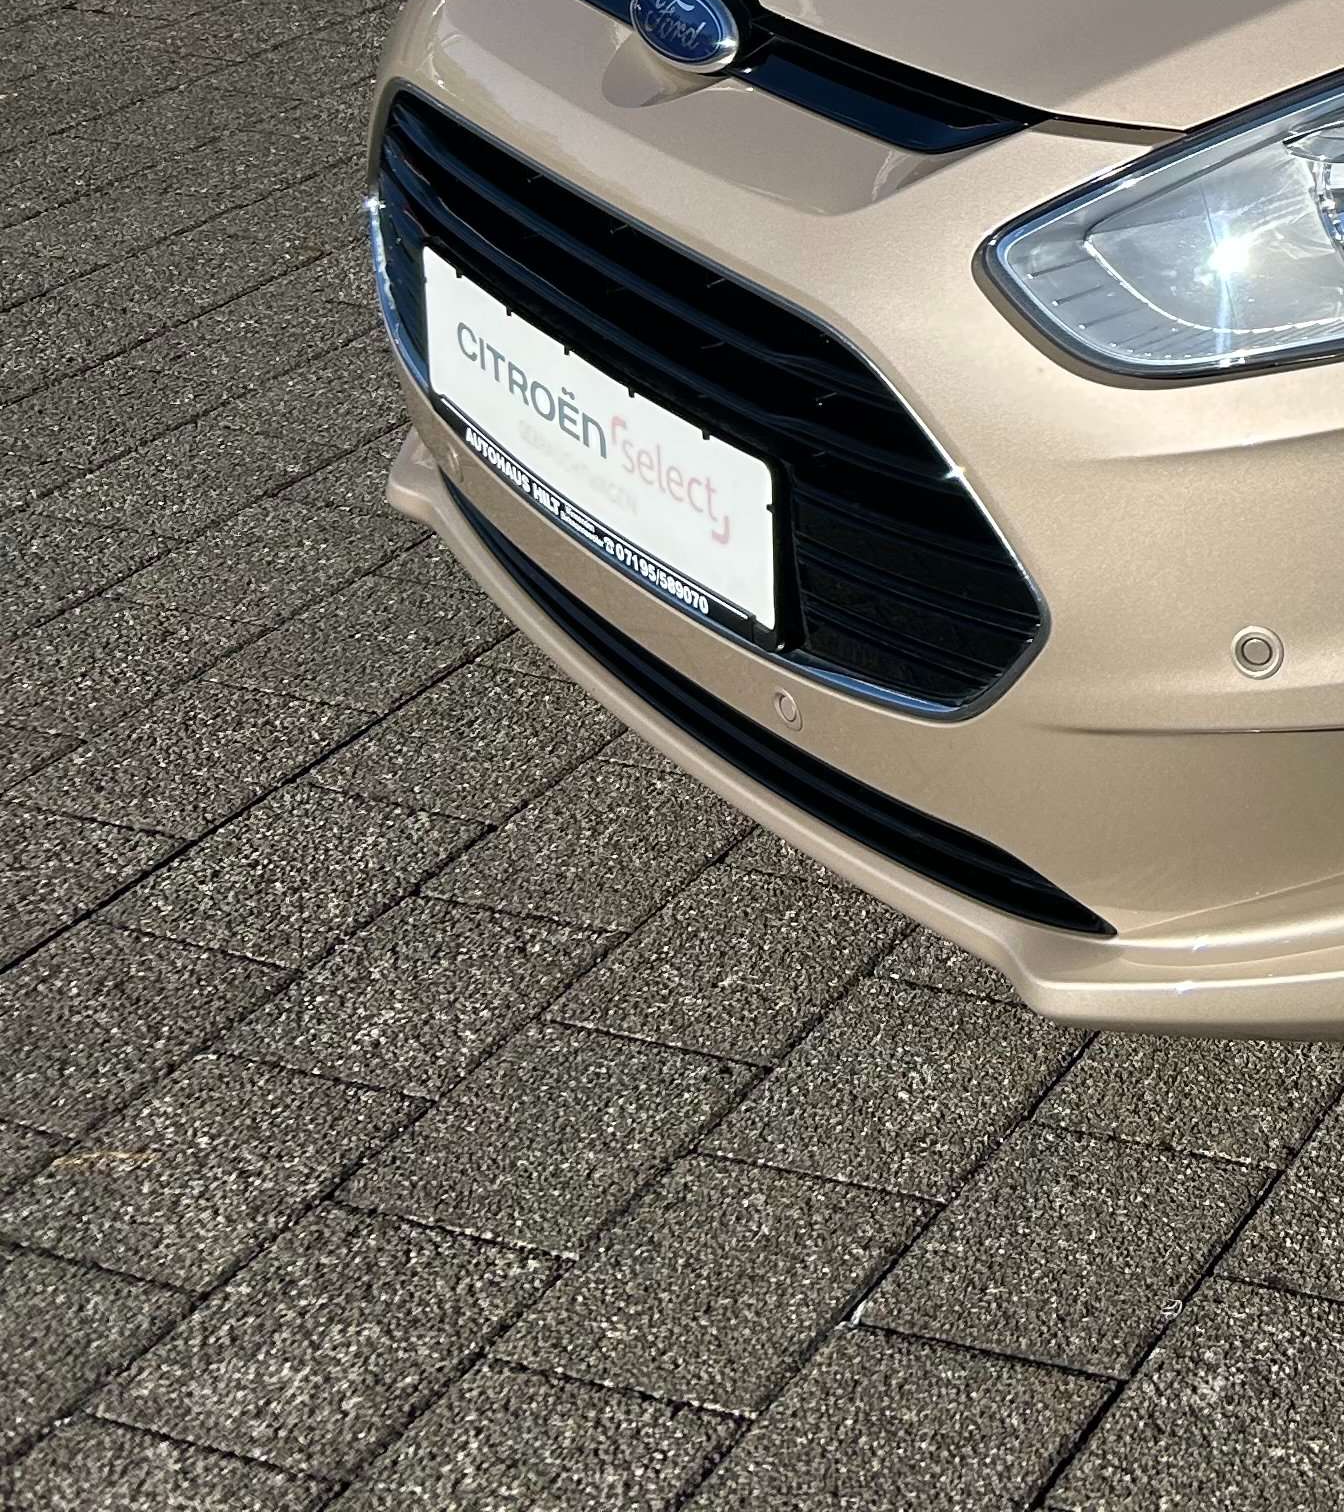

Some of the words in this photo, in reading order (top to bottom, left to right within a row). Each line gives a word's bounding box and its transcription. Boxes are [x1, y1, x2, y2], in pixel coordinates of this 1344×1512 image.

[466, 426, 531, 493] AUTOHAUS
[532, 482, 561, 516] HILT
[615, 542, 709, 615] 07195/589070
[622, 438, 719, 522] select
